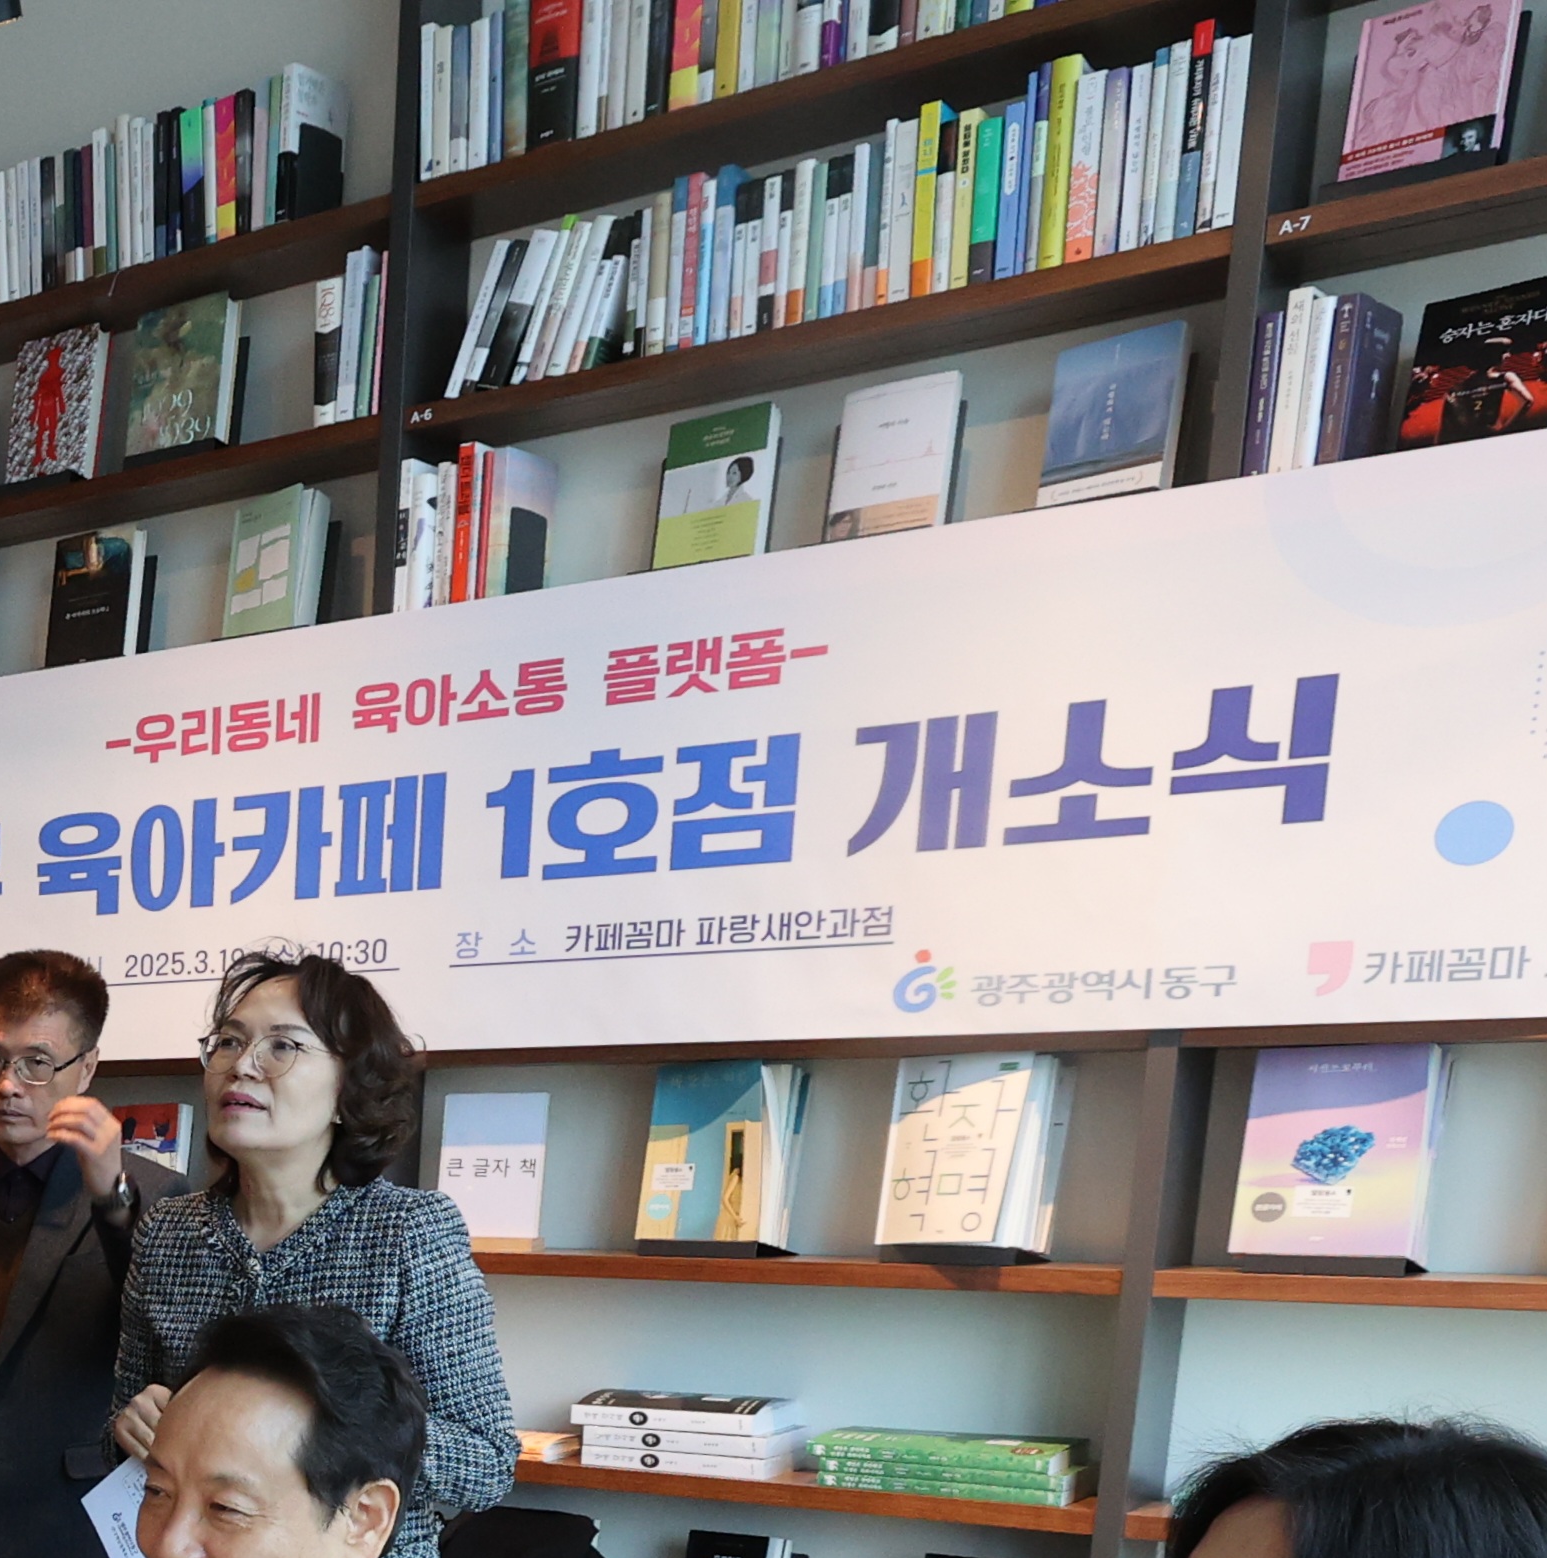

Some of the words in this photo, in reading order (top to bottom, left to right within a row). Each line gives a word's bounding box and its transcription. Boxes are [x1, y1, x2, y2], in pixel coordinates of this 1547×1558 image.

[1279, 215, 1312, 237] A-7
[1439, 320, 1494, 344] 승자는
[410, 408, 433, 425] A-6
[352, 657, 569, 735] 육아소통
[36, 771, 448, 916] 육아카페
[485, 732, 802, 881] 1호점
[846, 673, 1340, 858] 개소식
[455, 930, 484, 960] 장
[508, 928, 537, 957] 소
[564, 914, 686, 953] 카페꼼마
[694, 904, 894, 948] 파랑새안과점
[970, 968, 1153, 1007] 광주광역시
[1159, 963, 1238, 999] 동구
[1363, 944, 1531, 986] 카페꼼마
[446, 1158, 463, 1178] 큰
[472, 1157, 511, 1178] 글자
[519, 1156, 538, 1178] 책
